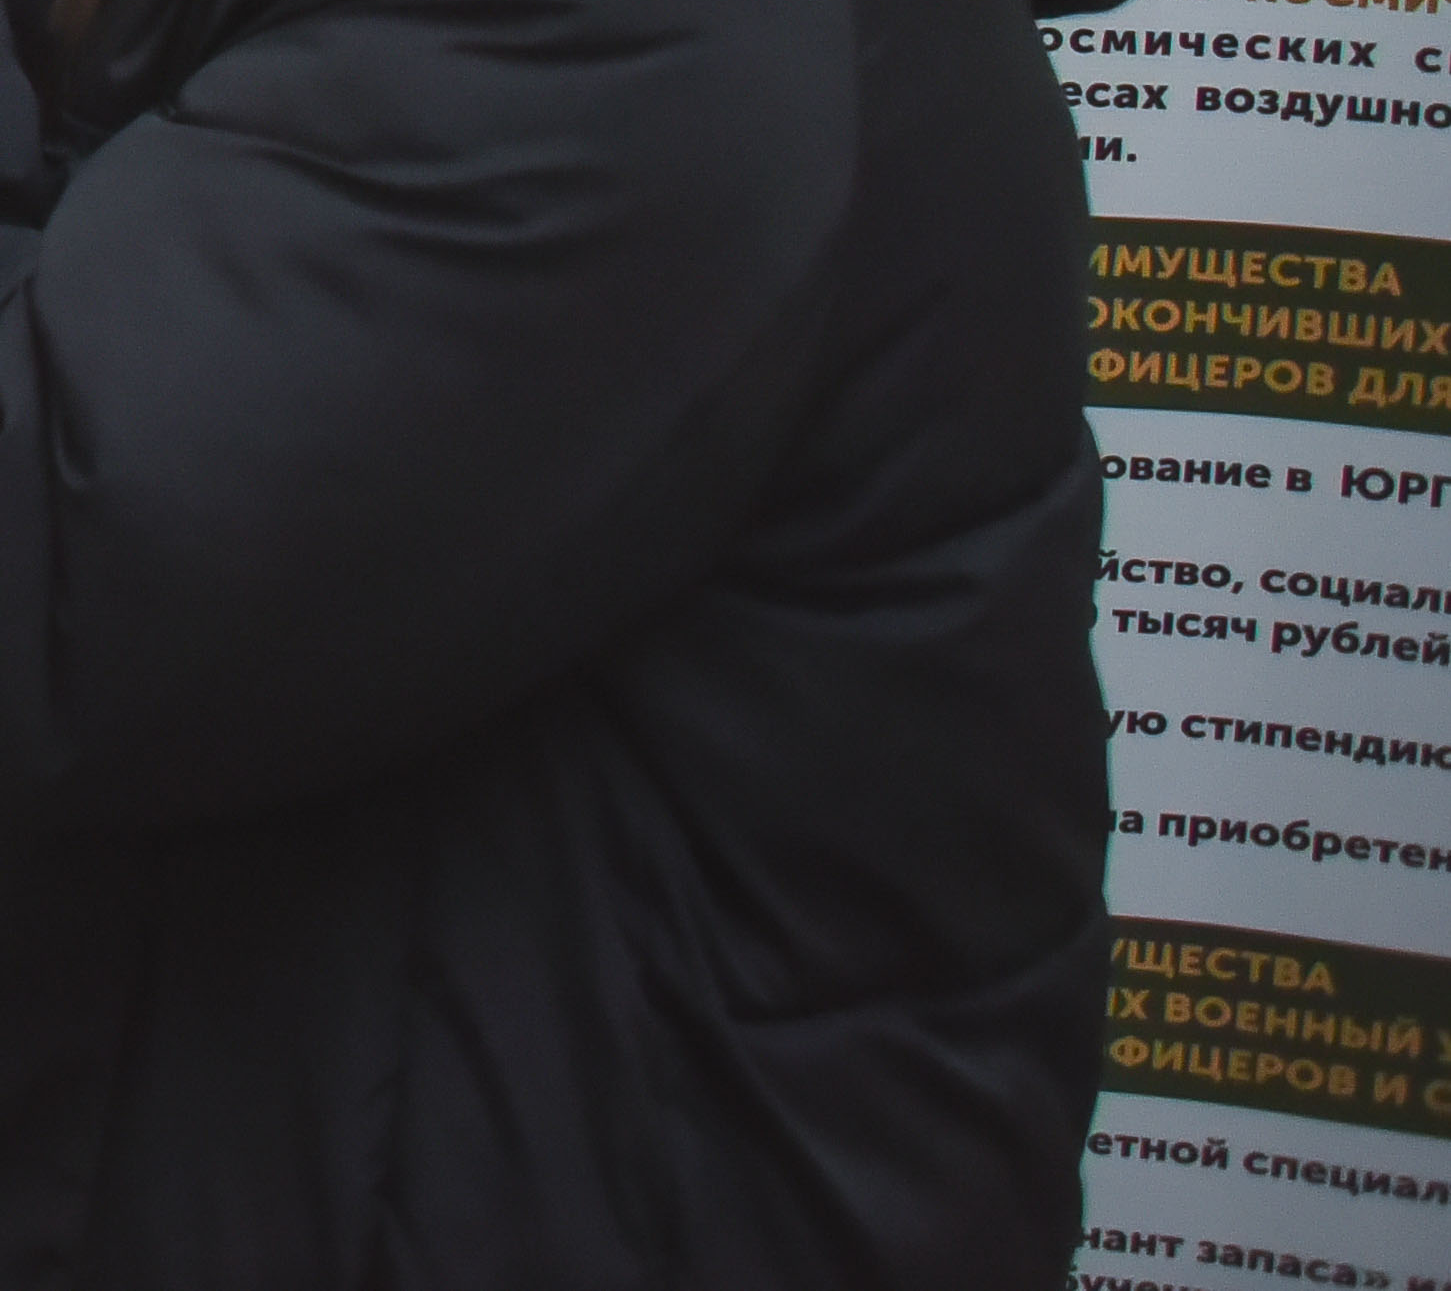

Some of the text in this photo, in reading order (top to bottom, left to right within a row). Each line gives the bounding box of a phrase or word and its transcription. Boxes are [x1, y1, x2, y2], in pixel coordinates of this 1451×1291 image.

[1039, 27, 1378, 68] осмических
[1062, 81, 1451, 128] есах воздушно
[1087, 347, 1335, 396] ФИЦЕРОВ
[1100, 453, 1272, 489] ование
[1286, 465, 1313, 493] в
[1112, 608, 1451, 668] тысяч рублей
[1164, 991, 1424, 1062] ВОЕННЫЙ
[1108, 1034, 1358, 1098] ФИЦЕРОВ
[1372, 1071, 1410, 1106] И
[1086, 1131, 1230, 1170] етной
